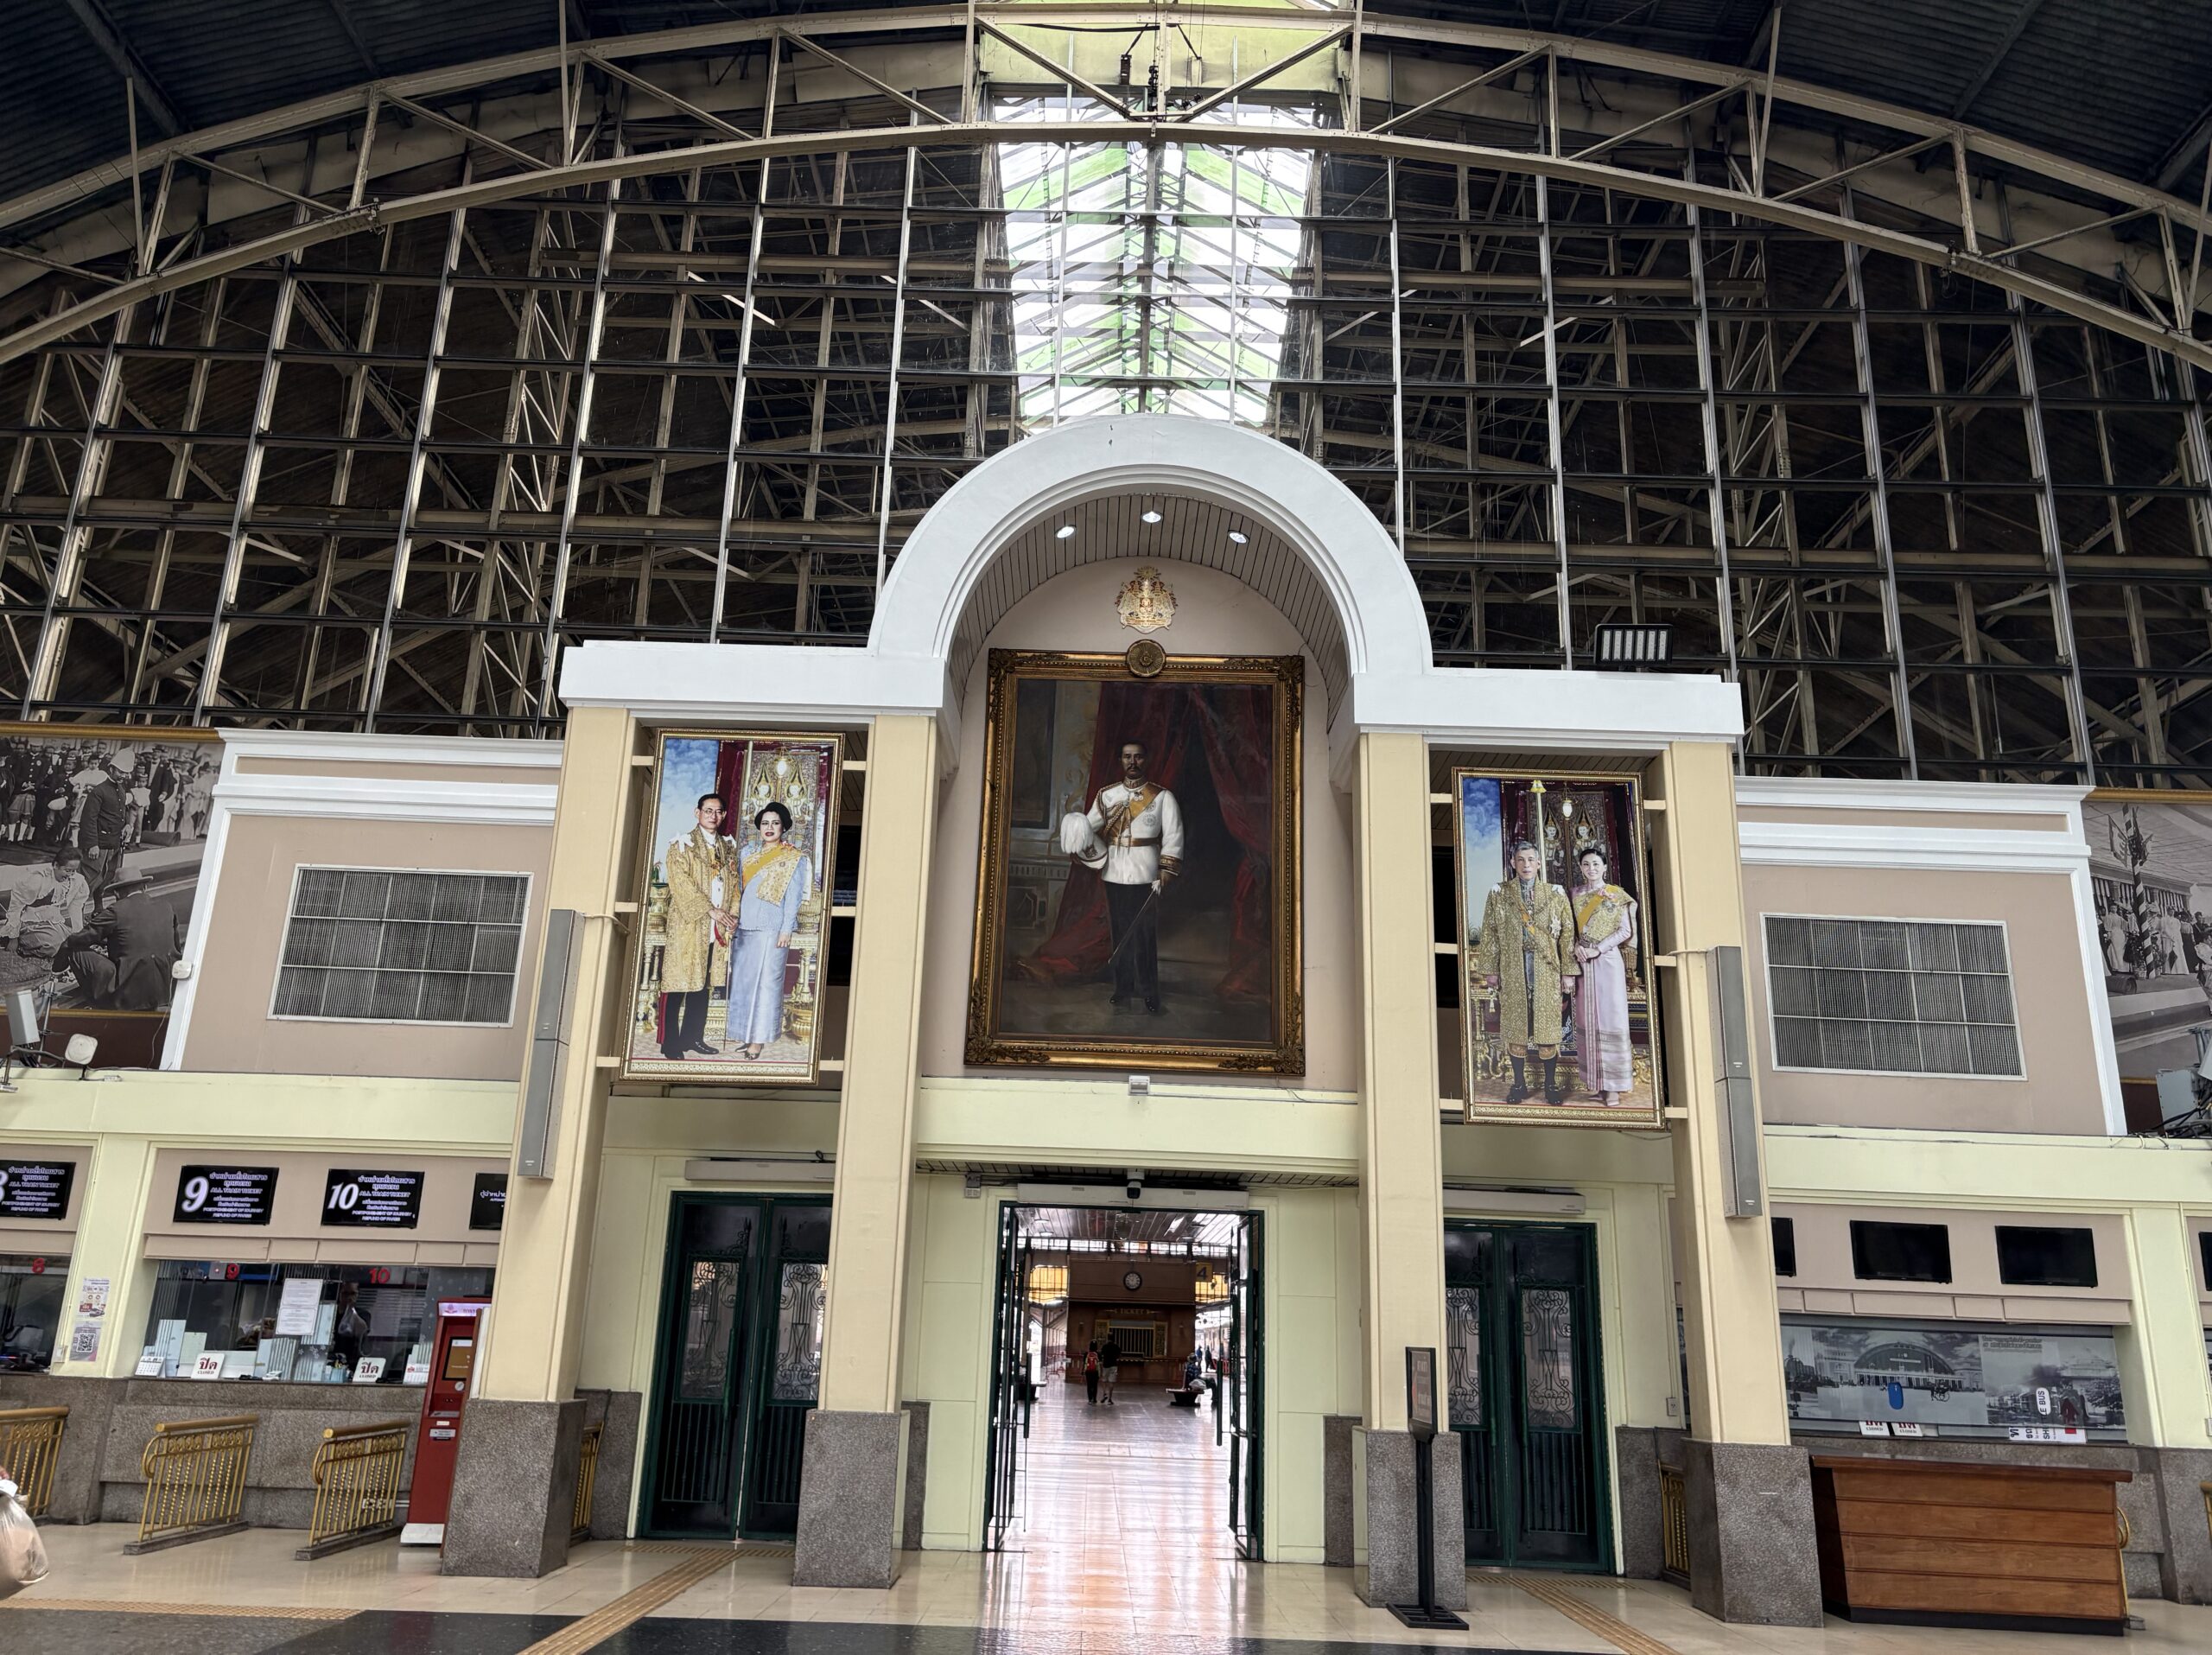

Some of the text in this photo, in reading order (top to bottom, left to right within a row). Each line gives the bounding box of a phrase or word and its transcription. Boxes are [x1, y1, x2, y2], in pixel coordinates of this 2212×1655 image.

[181, 1175, 209, 1213] 9
[327, 1182, 359, 1210] 10
[32, 1257, 45, 1274] 8
[226, 1264, 240, 1280] 9
[1197, 1267, 1208, 1280] 4
[368, 1267, 391, 1284] 10
[199, 1358, 218, 1370] ปิด
[360, 1361, 379, 1374] ปิด
[2037, 1390, 2046, 1405] BUS
